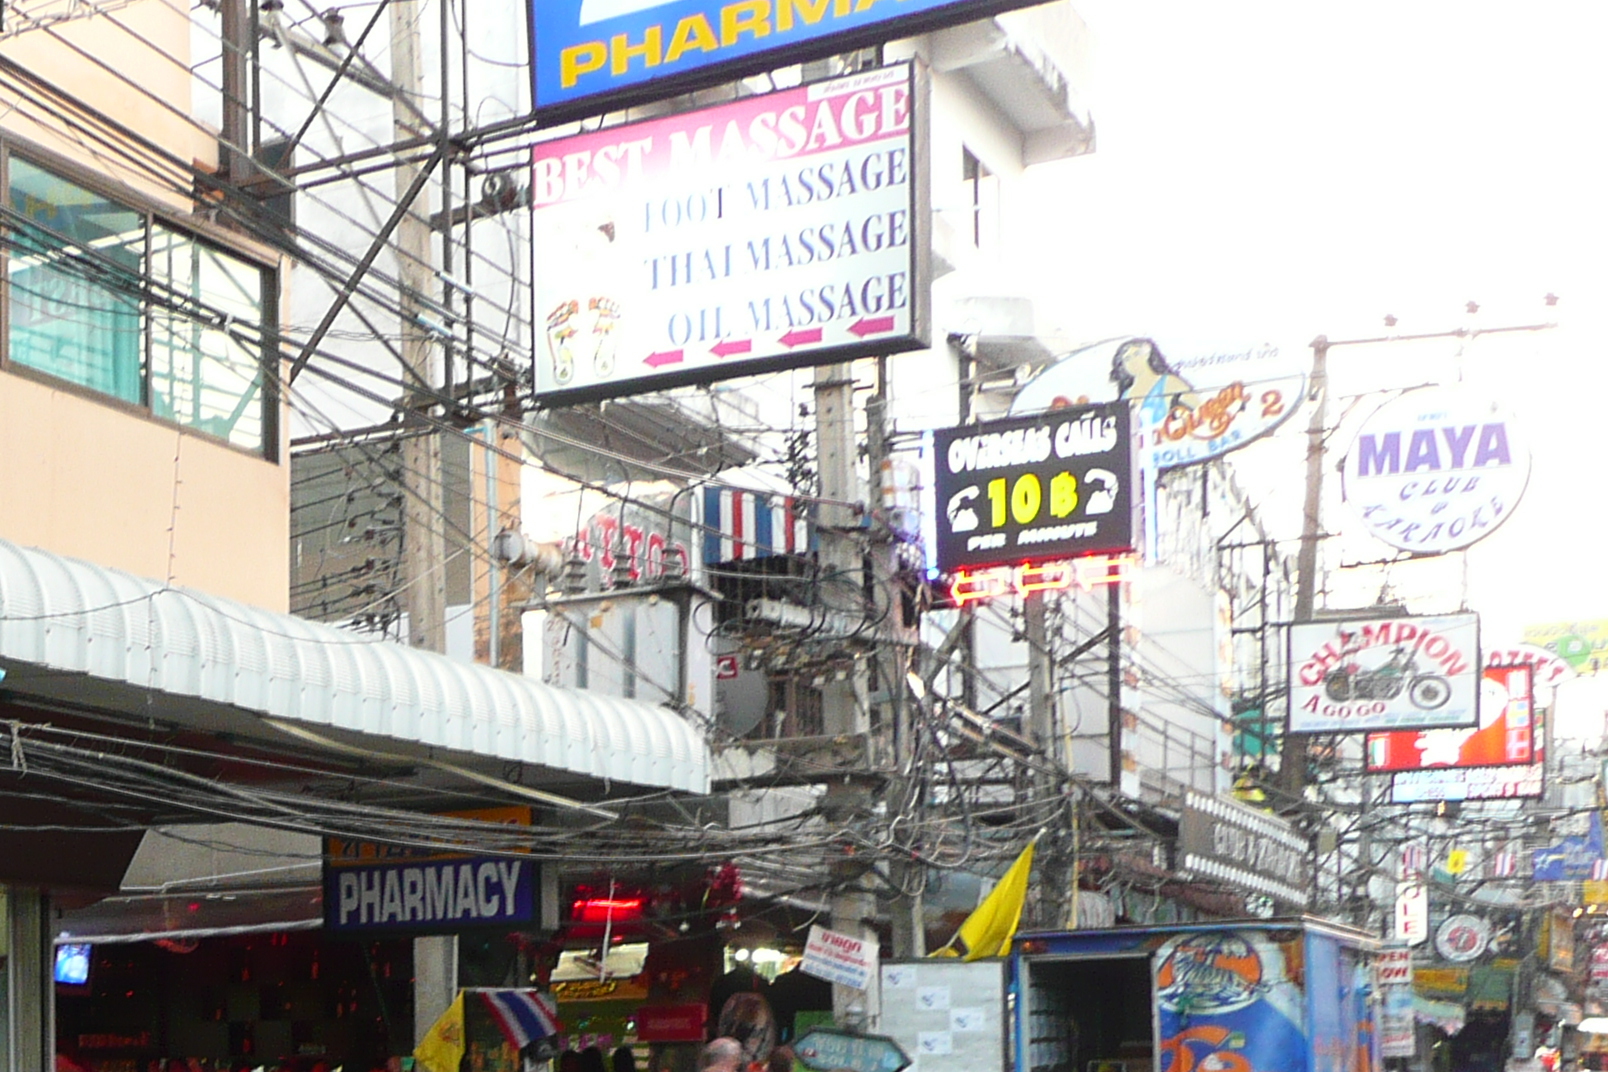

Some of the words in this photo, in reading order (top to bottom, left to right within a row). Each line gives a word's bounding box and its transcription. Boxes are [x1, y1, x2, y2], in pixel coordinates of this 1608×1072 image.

[534, 136, 653, 208] BEST
[669, 86, 910, 173] MASSAGE
[745, 148, 908, 212] MASSAGE
[745, 209, 908, 272] MASSAGE
[745, 271, 908, 335] MASSAGE
[947, 425, 1052, 475] OVERSEAS
[1055, 411, 1118, 459] CALLS
[1357, 421, 1513, 479] MAYA
[987, 472, 1042, 528] 10
[1298, 621, 1470, 687] CHAMPION
[1321, 702, 1352, 719] GO
[1355, 700, 1386, 718] GO
[338, 860, 522, 925] PHARMACY
